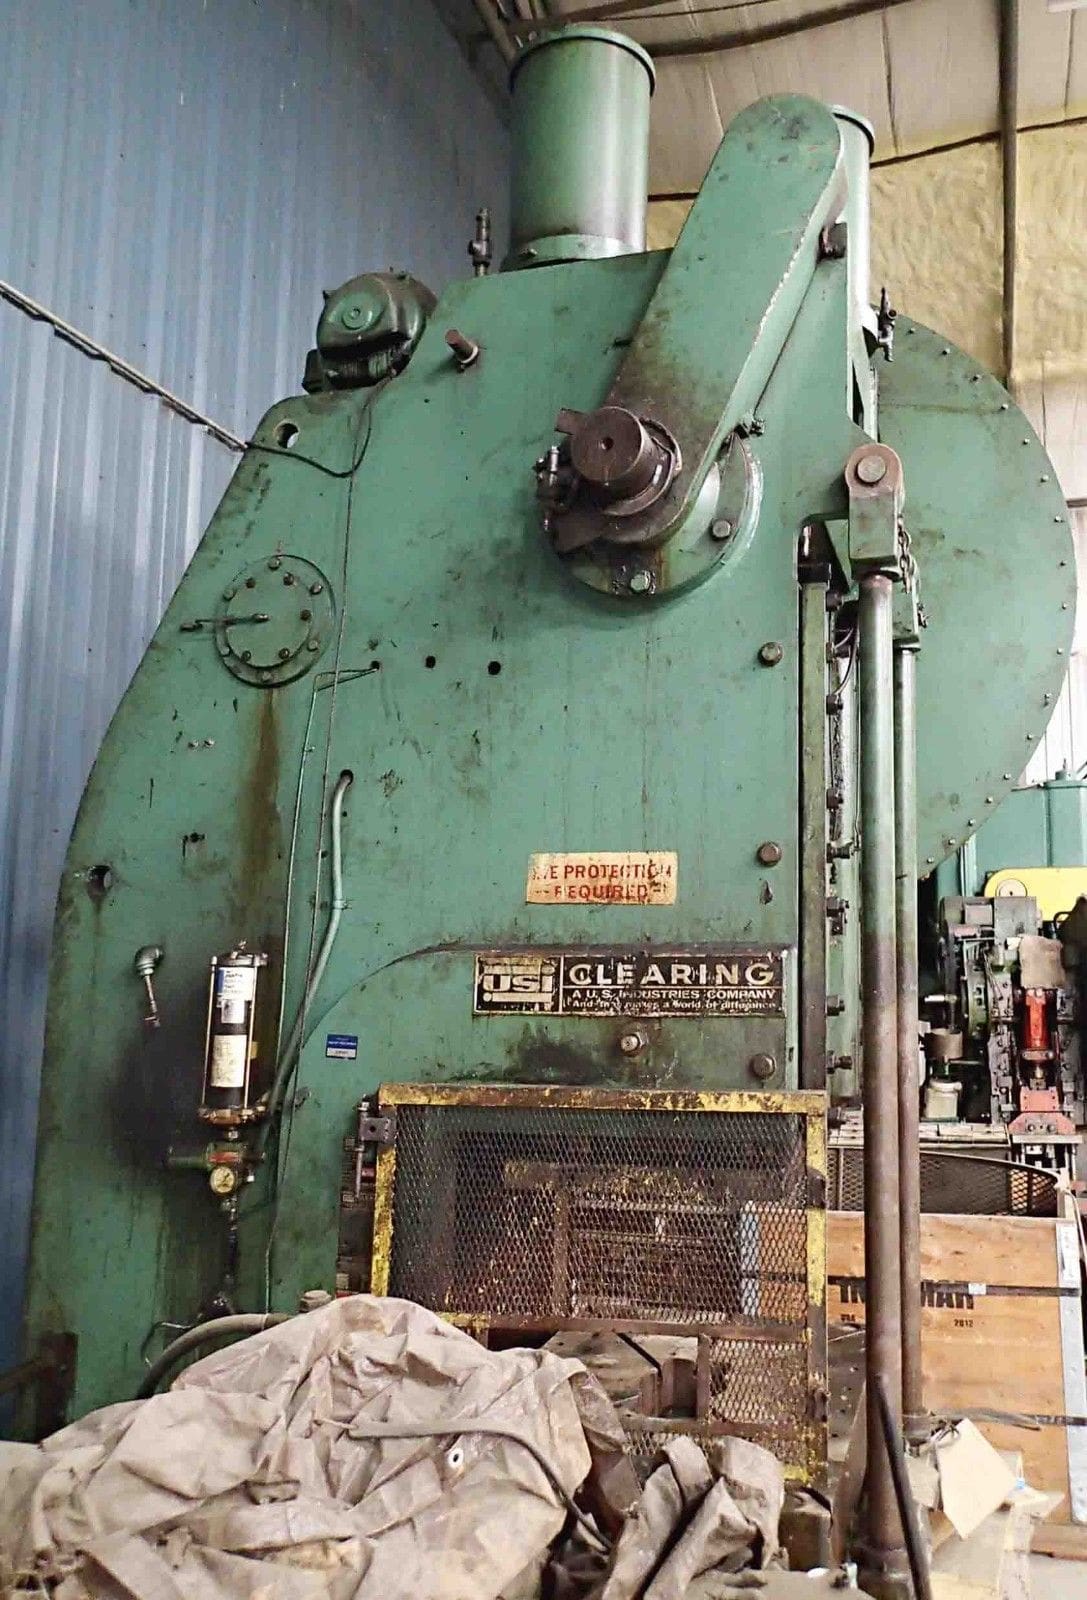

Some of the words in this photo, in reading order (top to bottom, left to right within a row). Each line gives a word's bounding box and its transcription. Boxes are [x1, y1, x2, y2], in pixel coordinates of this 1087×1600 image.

[568, 962, 775, 986] CLEARING
[572, 989, 582, 999] A
[618, 989, 700, 999] INDUSTRIES
[706, 989, 776, 999] COMPANY
